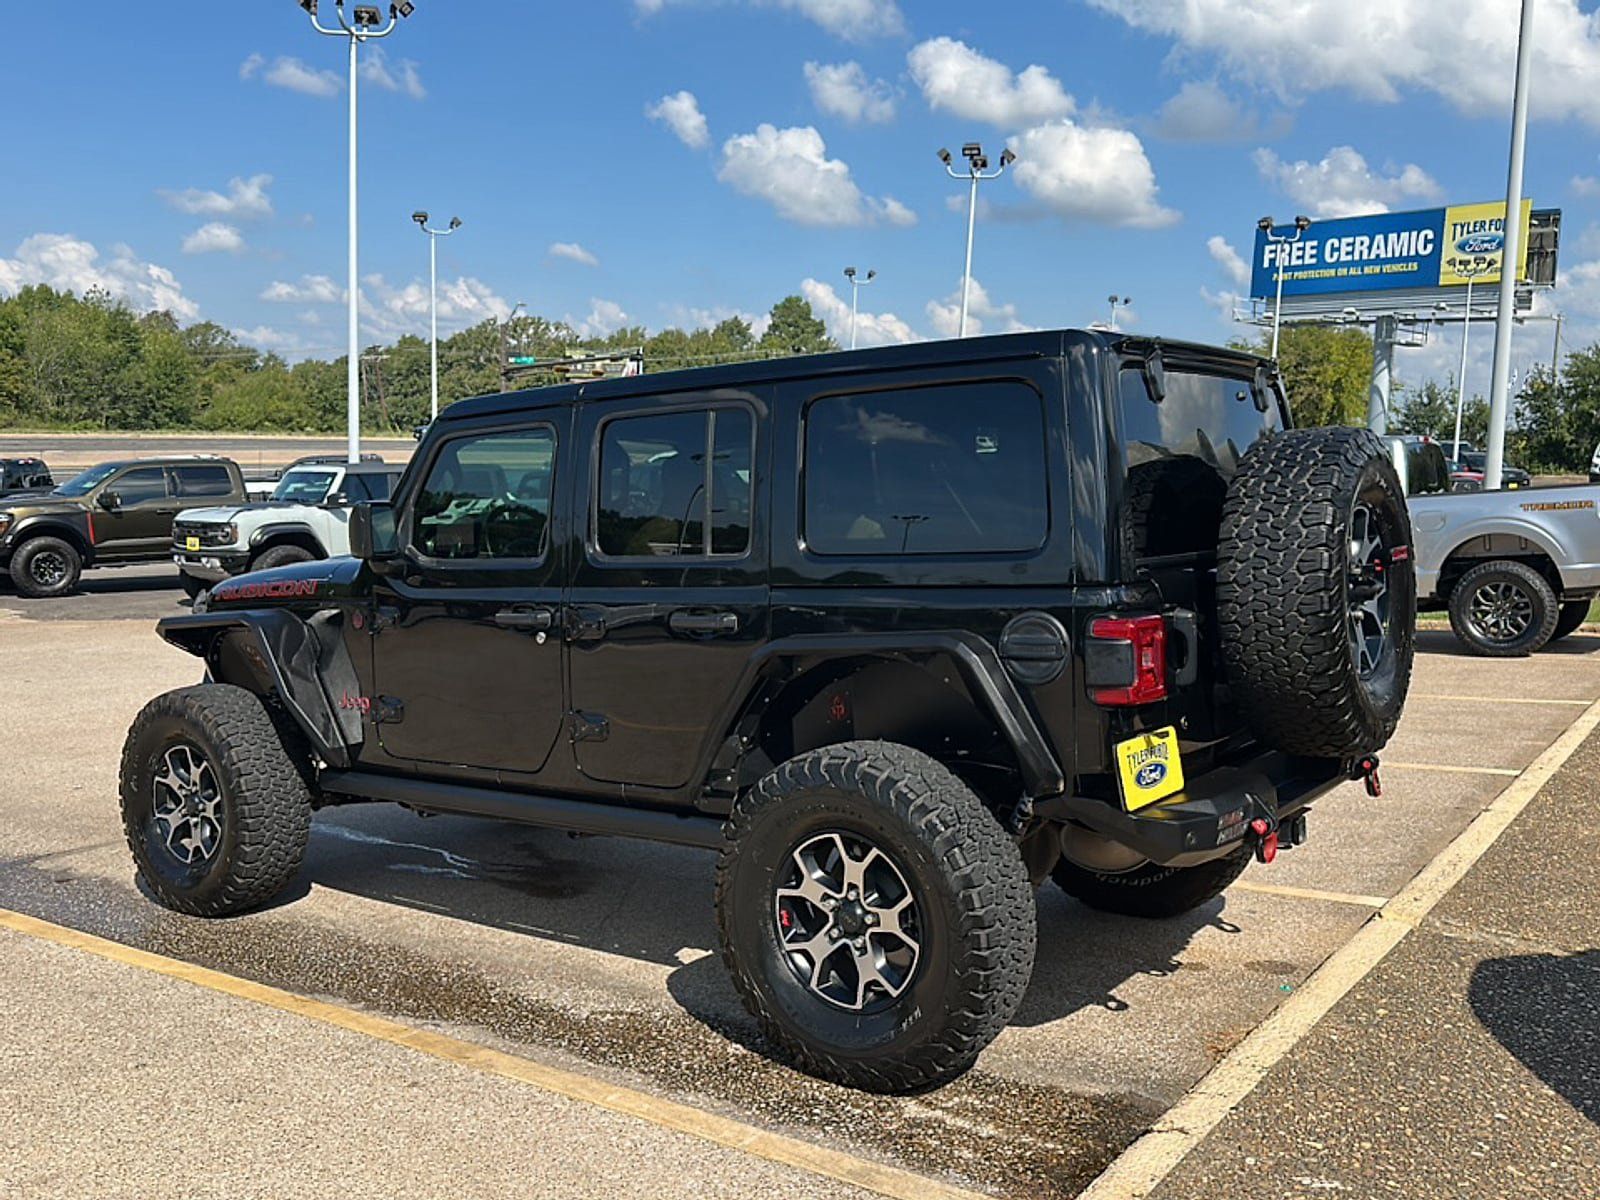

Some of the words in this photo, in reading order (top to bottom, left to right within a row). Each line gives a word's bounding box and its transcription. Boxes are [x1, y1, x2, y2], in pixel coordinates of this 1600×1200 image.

[1451, 219, 1487, 242] TYLER
[1488, 217, 1505, 233] FO
[1263, 240, 1319, 268] FREE
[1324, 229, 1435, 264] CERAMIC
[1465, 236, 1500, 252] Ford
[1349, 266, 1362, 276] ALL
[215, 580, 319, 601] RUBICON
[338, 687, 371, 715] Jeep
